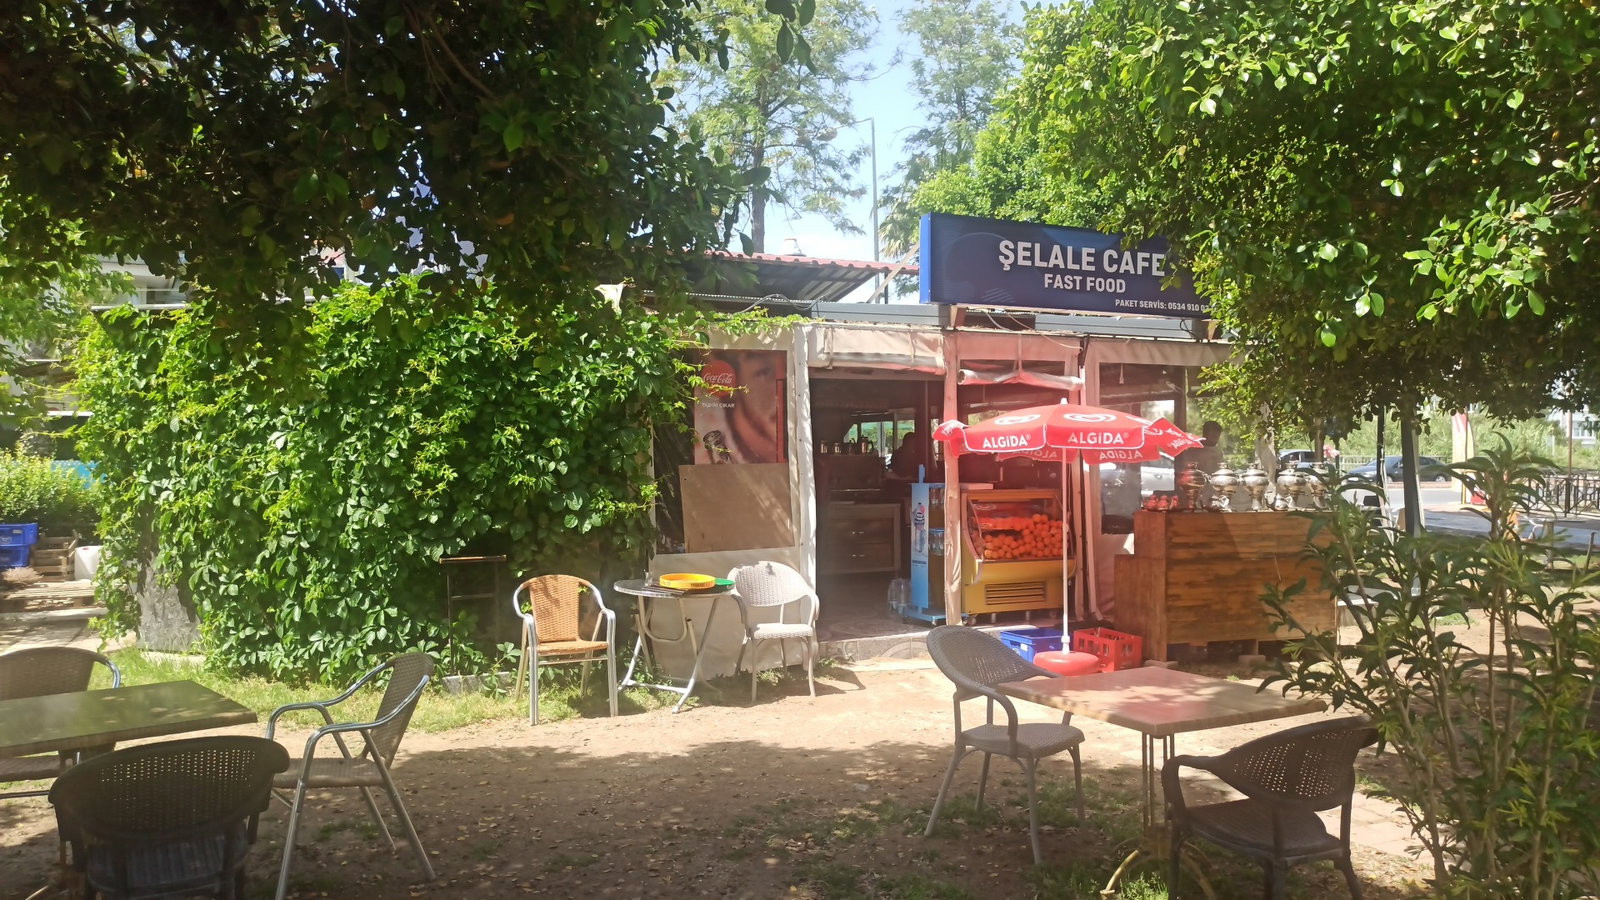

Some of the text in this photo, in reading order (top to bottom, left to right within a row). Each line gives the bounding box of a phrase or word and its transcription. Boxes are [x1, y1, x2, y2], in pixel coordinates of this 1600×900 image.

[999, 239, 1166, 276] ŞELALE CAFE
[1044, 273, 1126, 293] FAST FOOD
[1115, 299, 1138, 308] PAKET
[1168, 302, 1186, 311] 0534
